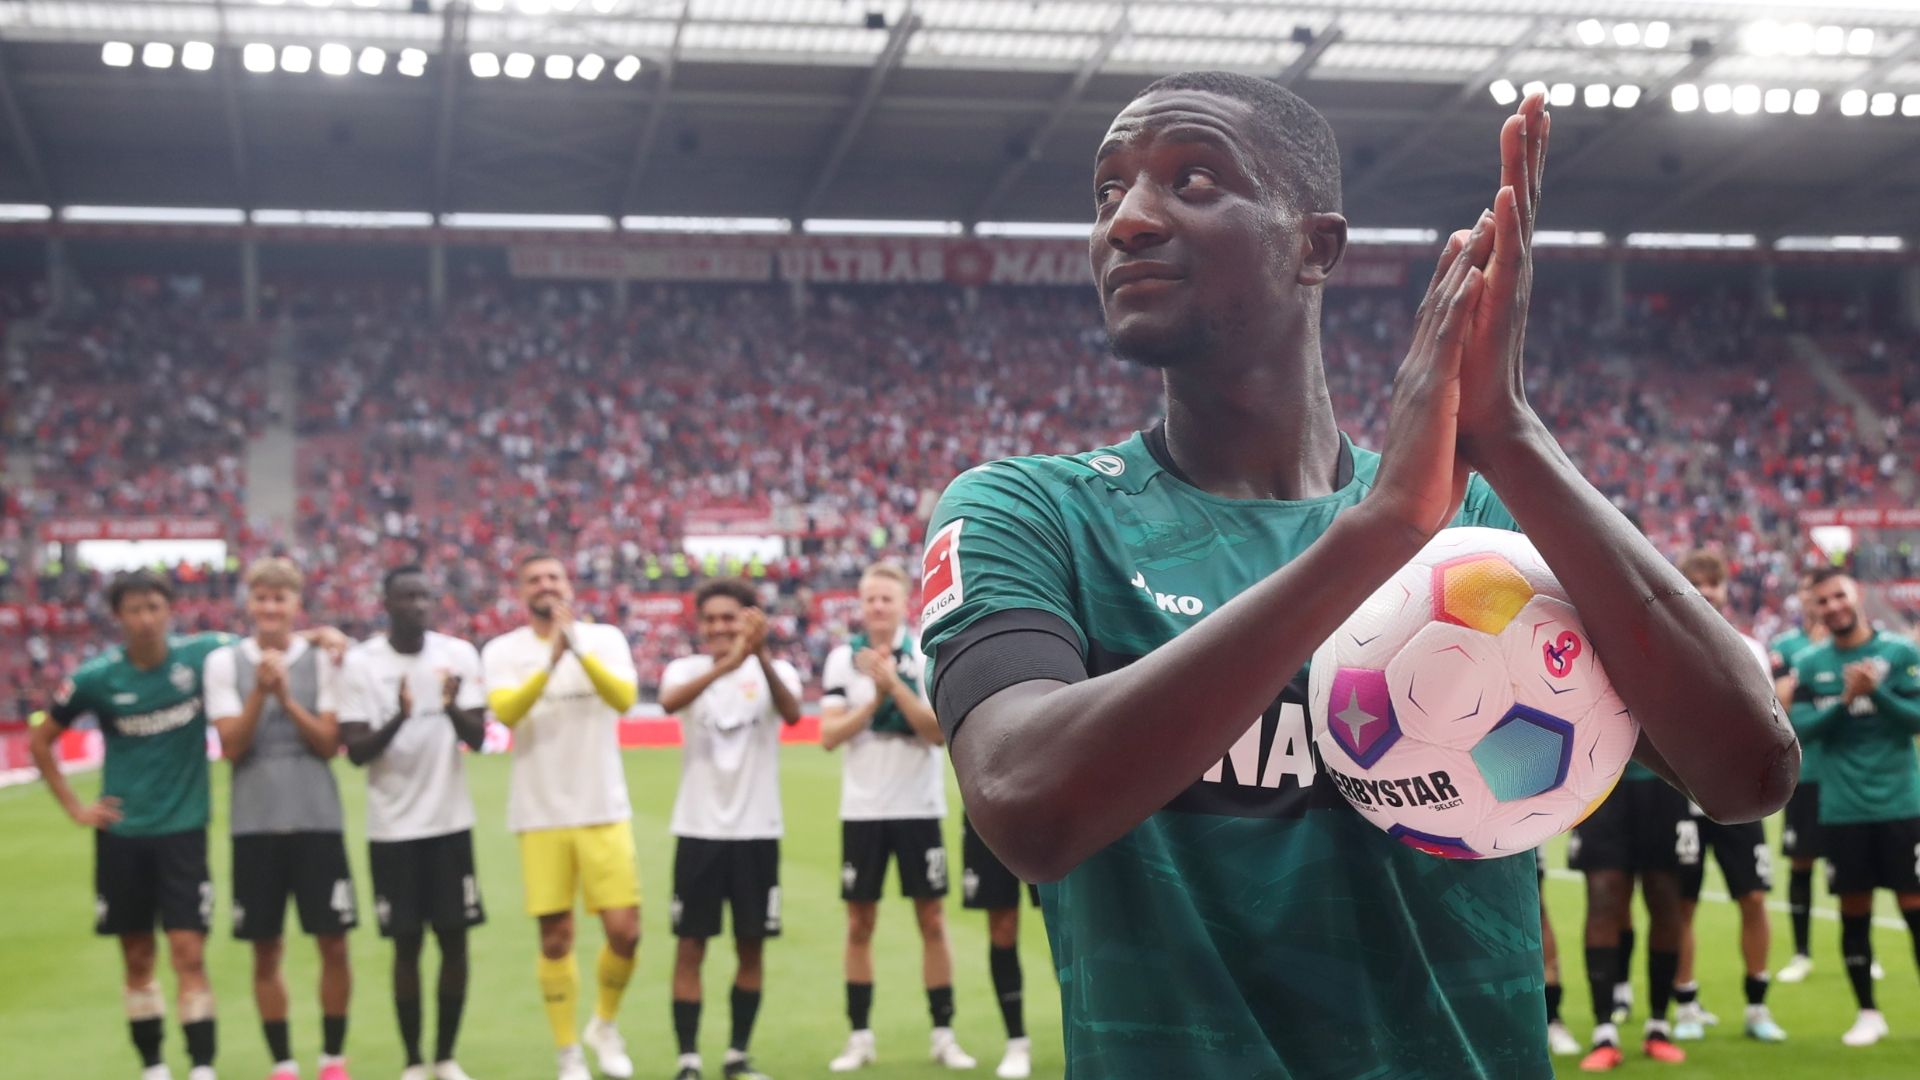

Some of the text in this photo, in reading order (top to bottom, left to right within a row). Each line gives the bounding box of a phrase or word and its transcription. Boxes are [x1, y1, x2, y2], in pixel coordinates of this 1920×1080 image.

[780, 250, 947, 283] ULTRAS
[1131, 570, 1204, 616] JKO
[1202, 701, 1316, 788] NA
[1325, 763, 1460, 808] ERBYSTAR
[1434, 798, 1465, 812] SELECT
